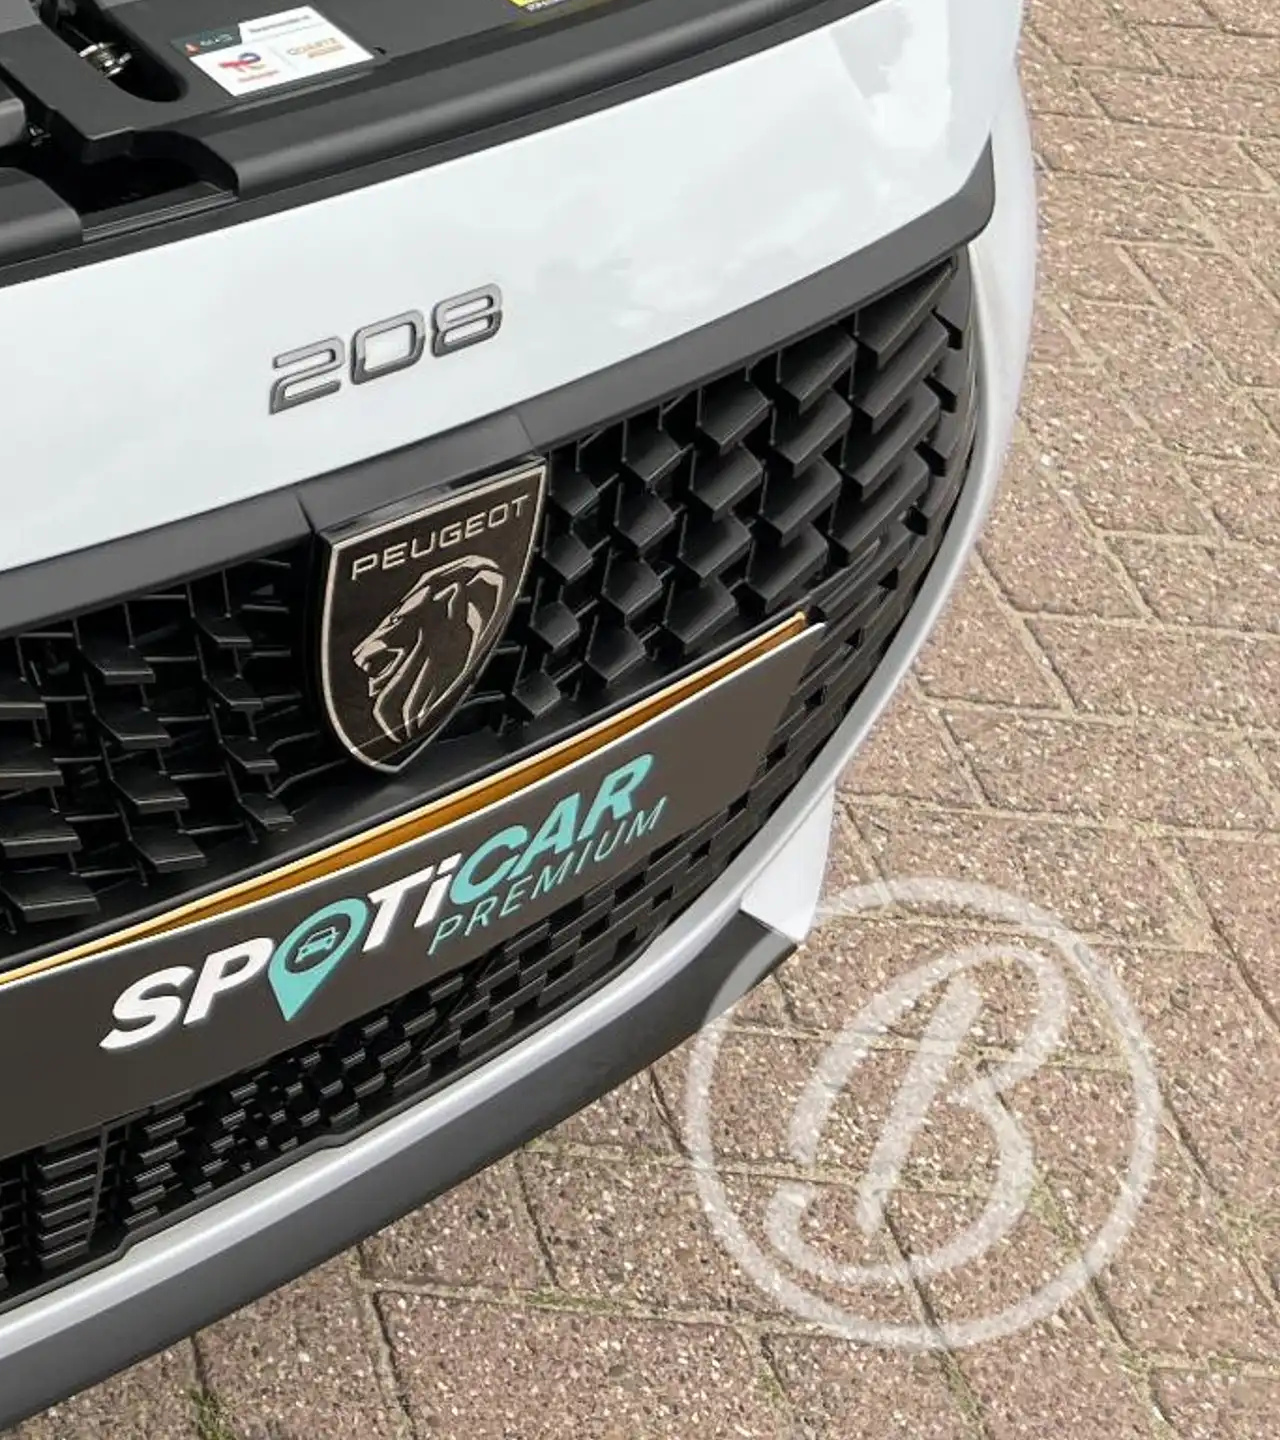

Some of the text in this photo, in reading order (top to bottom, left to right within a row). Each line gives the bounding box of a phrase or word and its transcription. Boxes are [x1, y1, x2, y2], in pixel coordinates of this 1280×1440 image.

[268, 283, 503, 415] 208
[351, 494, 530, 581] PEUGEOT
[427, 796, 667, 957] PREMIUM
